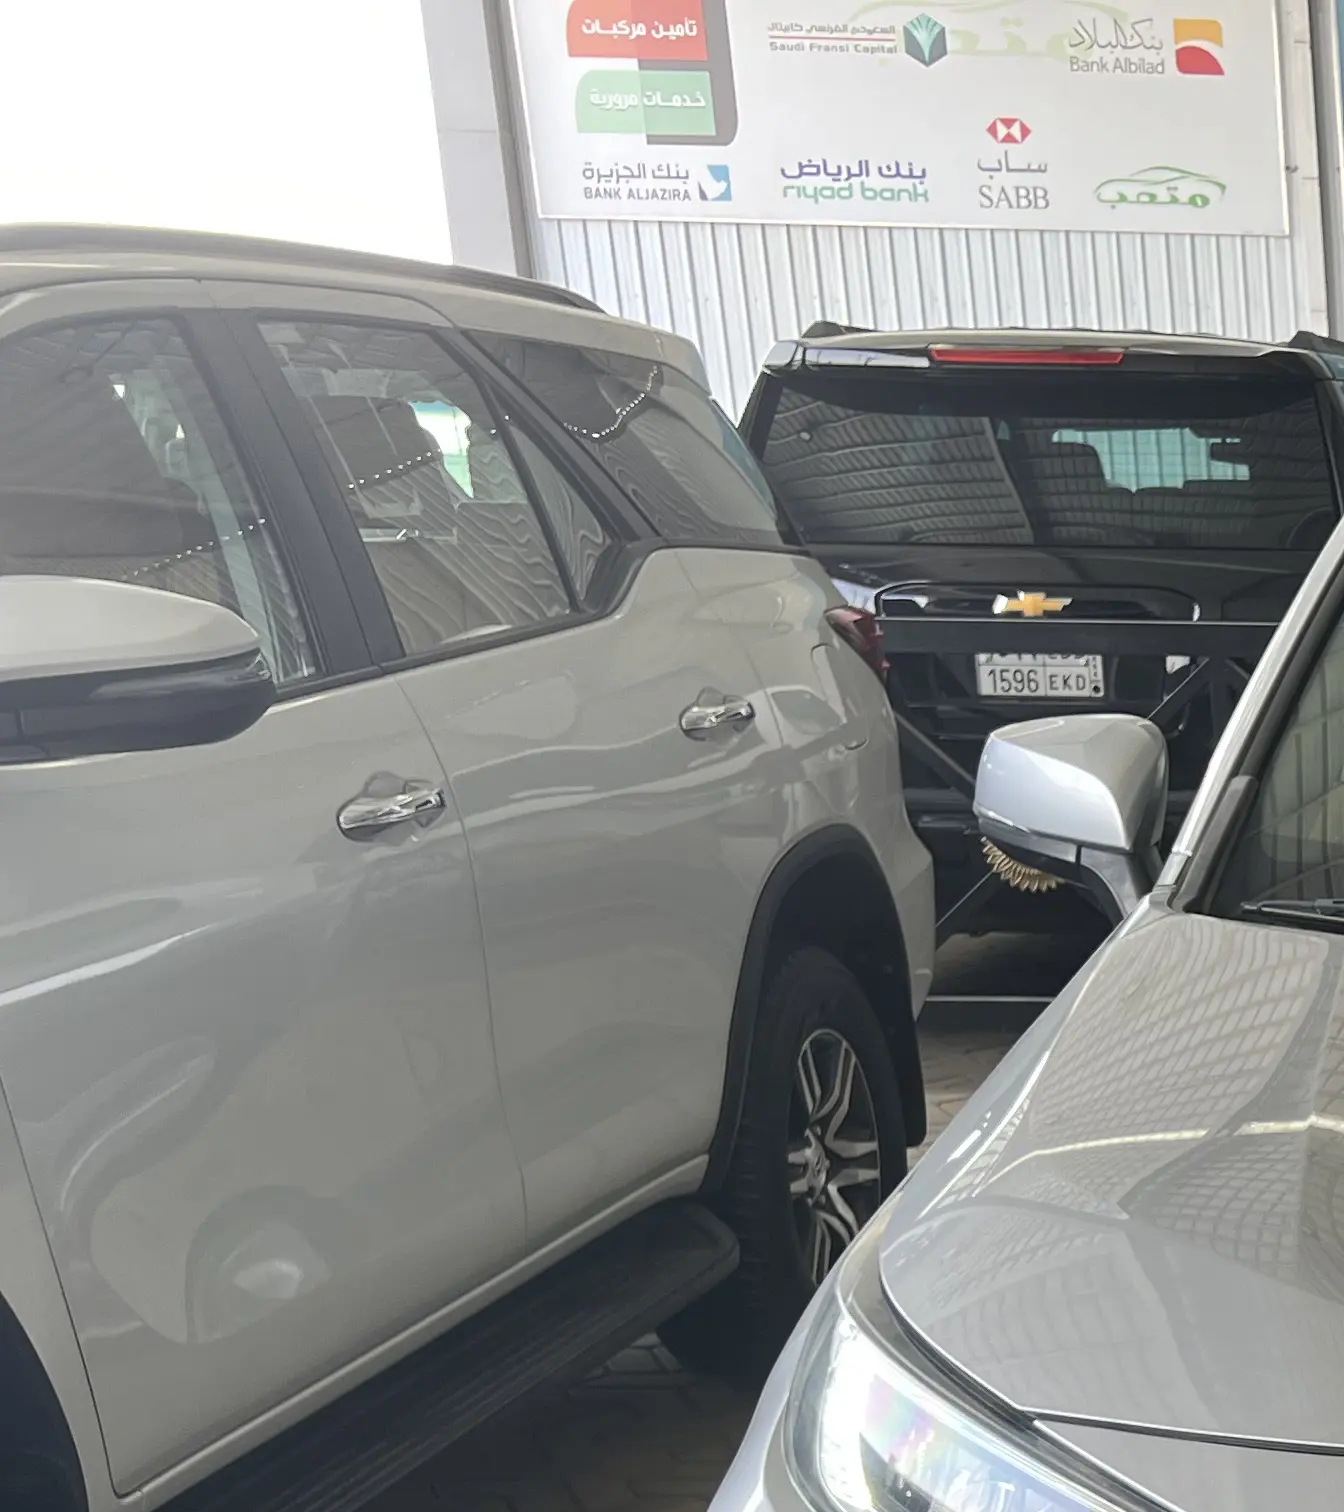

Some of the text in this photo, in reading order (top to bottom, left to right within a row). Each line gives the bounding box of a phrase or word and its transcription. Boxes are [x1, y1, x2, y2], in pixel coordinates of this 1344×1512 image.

[581, 17, 698, 40] تأمين مركبات
[1069, 18, 1127, 54] البلاد
[769, 41, 898, 55] Saudi Fransi Capital
[1069, 56, 1165, 74] Bank Albilad
[589, 88, 706, 111] خدمات مرورية
[582, 161, 690, 185] بنك الجزيرة
[781, 159, 926, 185] بنك الرياض
[977, 150, 1047, 180] ساب
[583, 187, 692, 202] BANK ALJAZIRA
[783, 180, 929, 204] riyad bank
[979, 184, 1049, 210] SABB
[988, 669, 1087, 693] 1596 EKD
